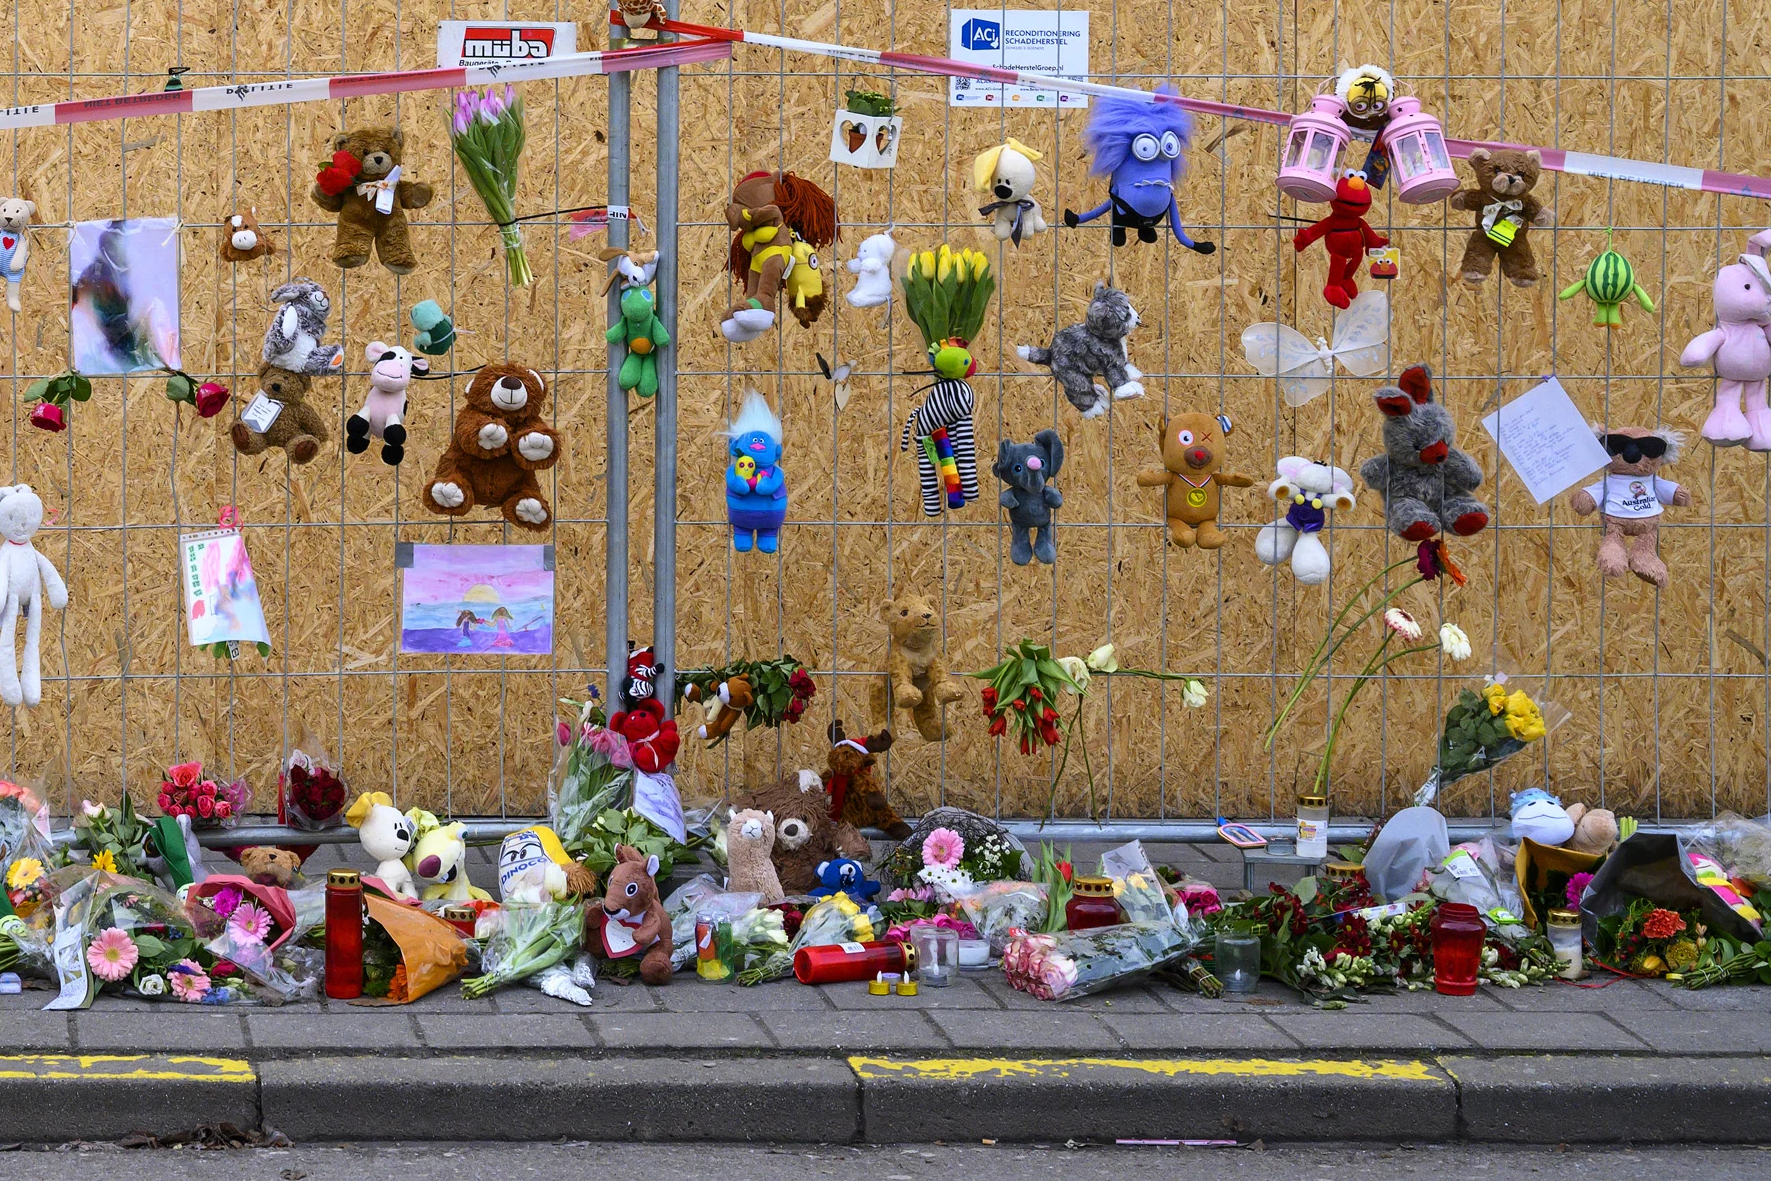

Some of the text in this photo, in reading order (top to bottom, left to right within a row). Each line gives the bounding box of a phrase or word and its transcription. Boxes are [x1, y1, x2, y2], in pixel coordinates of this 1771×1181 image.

[1005, 29, 1081, 37] RECONDITIONERING
[464, 29, 548, 58] müba
[1005, 37, 1068, 46] SCHADEHERSTEL
[1633, 503, 1652, 511] Gold
[501, 858, 548, 885] DINOCO
